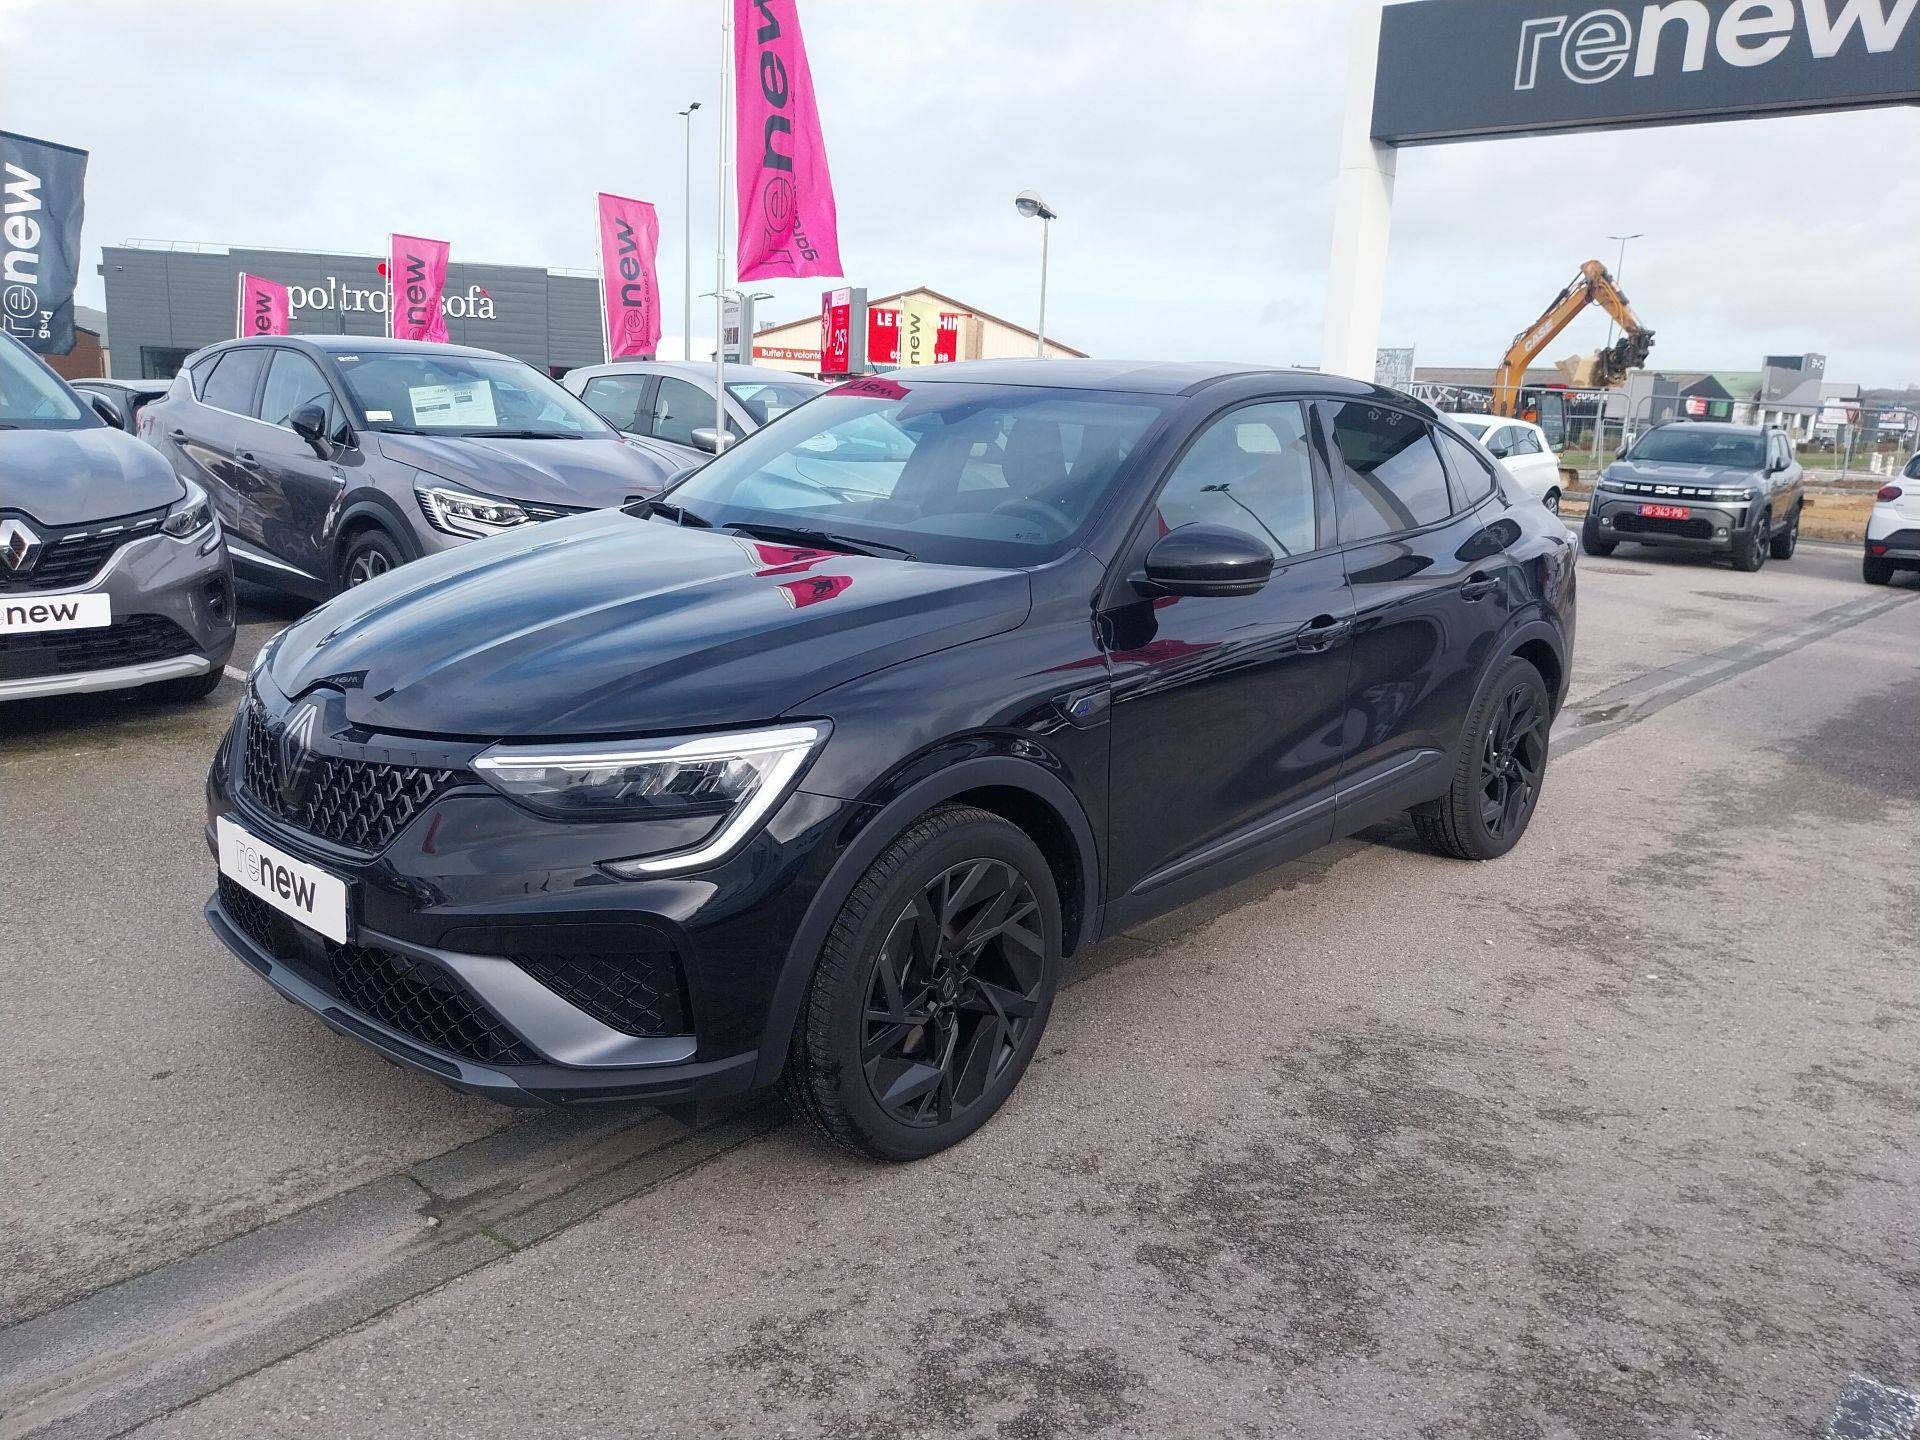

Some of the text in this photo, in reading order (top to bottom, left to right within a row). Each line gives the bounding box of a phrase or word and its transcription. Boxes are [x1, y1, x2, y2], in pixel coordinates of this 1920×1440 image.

[1514, 0, 1913, 91] renew
[3, 162, 42, 339] renew
[615, 218, 645, 351] renew
[877, 312, 893, 327] LE
[910, 313, 921, 365] new
[1524, 318, 1554, 352] CASE
[761, 348, 784, 358] Buffet
[794, 350, 822, 360] volonté
[0, 602, 79, 625] new
[235, 839, 316, 914] renew
